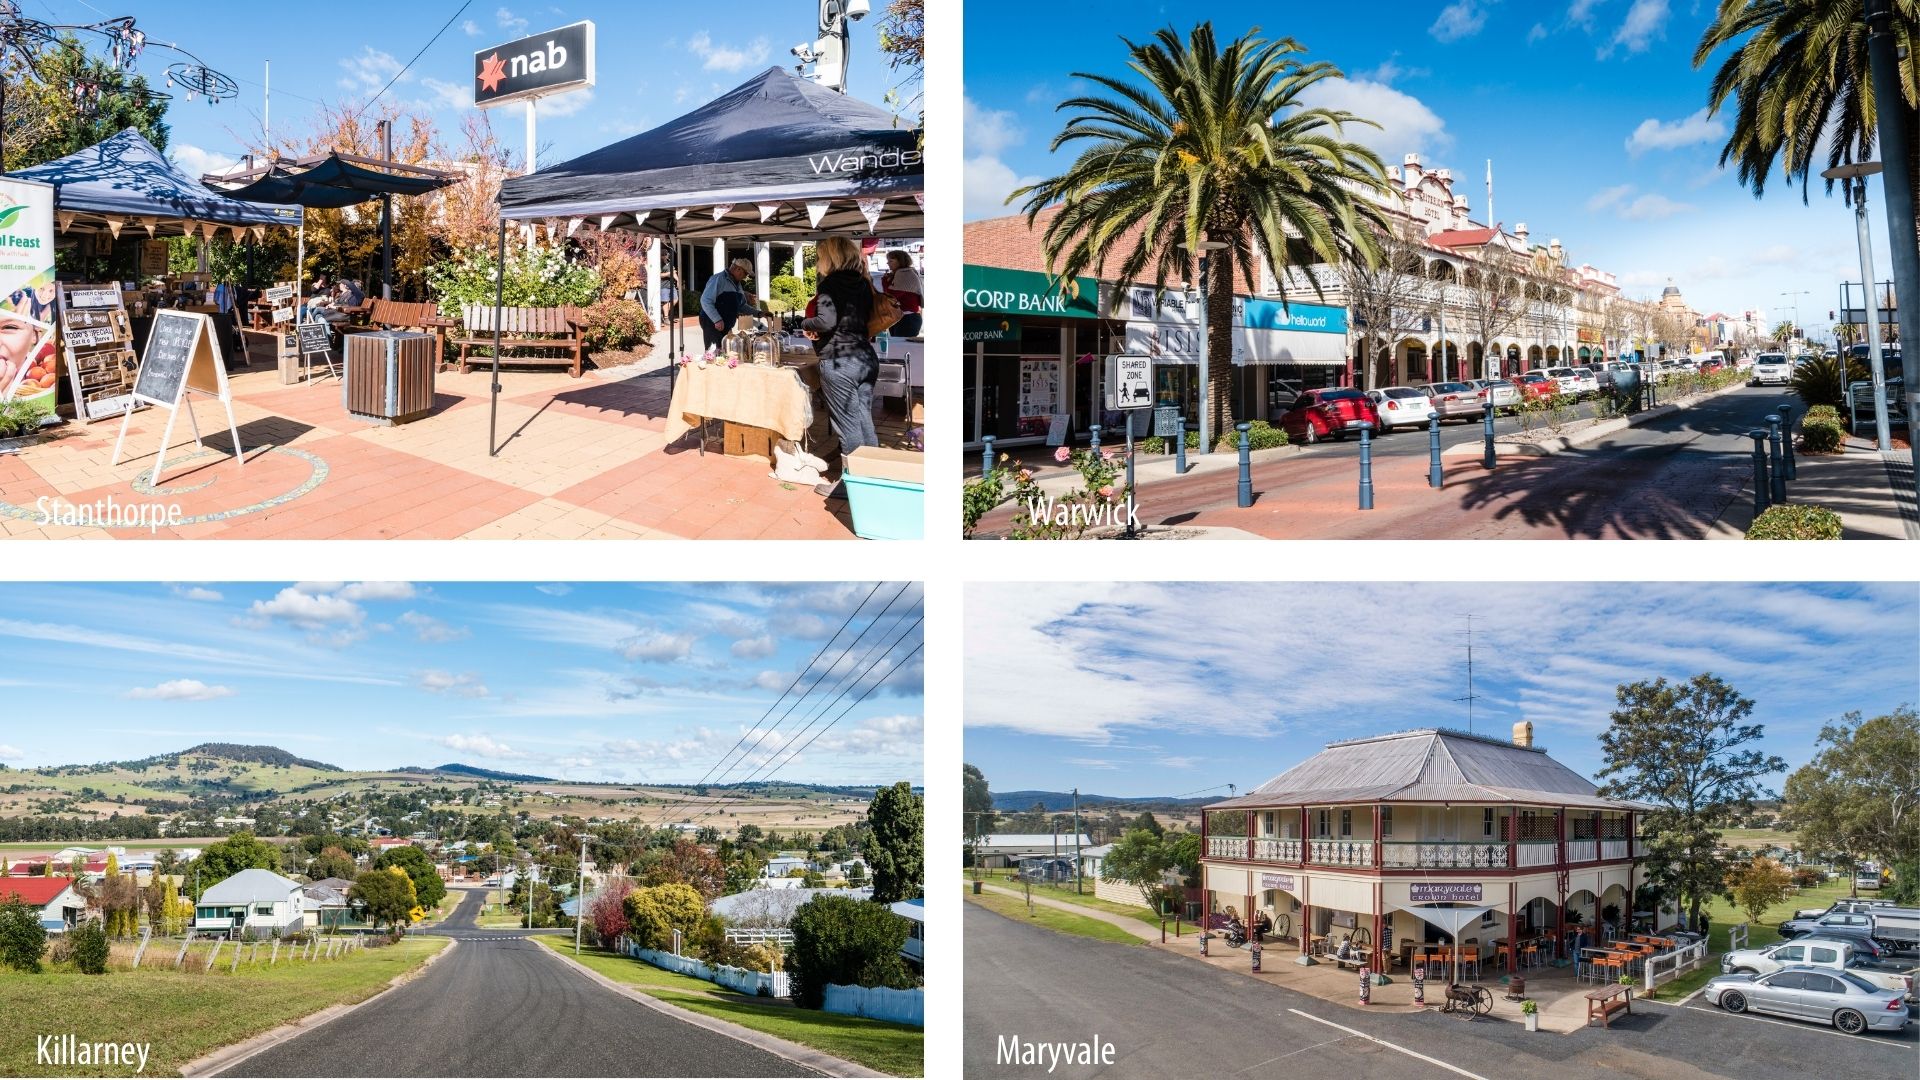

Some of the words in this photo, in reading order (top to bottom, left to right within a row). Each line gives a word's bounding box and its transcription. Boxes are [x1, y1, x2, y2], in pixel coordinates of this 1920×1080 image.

[511, 40, 567, 78] nab
[809, 148, 924, 174] Wande
[9, 235, 40, 248] Feast
[963, 288, 1015, 309] CORP
[1018, 292, 1066, 313] BANK
[1291, 314, 1326, 327] helloworld
[984, 330, 1003, 339] BANK
[1121, 360, 1147, 369] SHARED
[1126, 371, 1142, 380] ZONE
